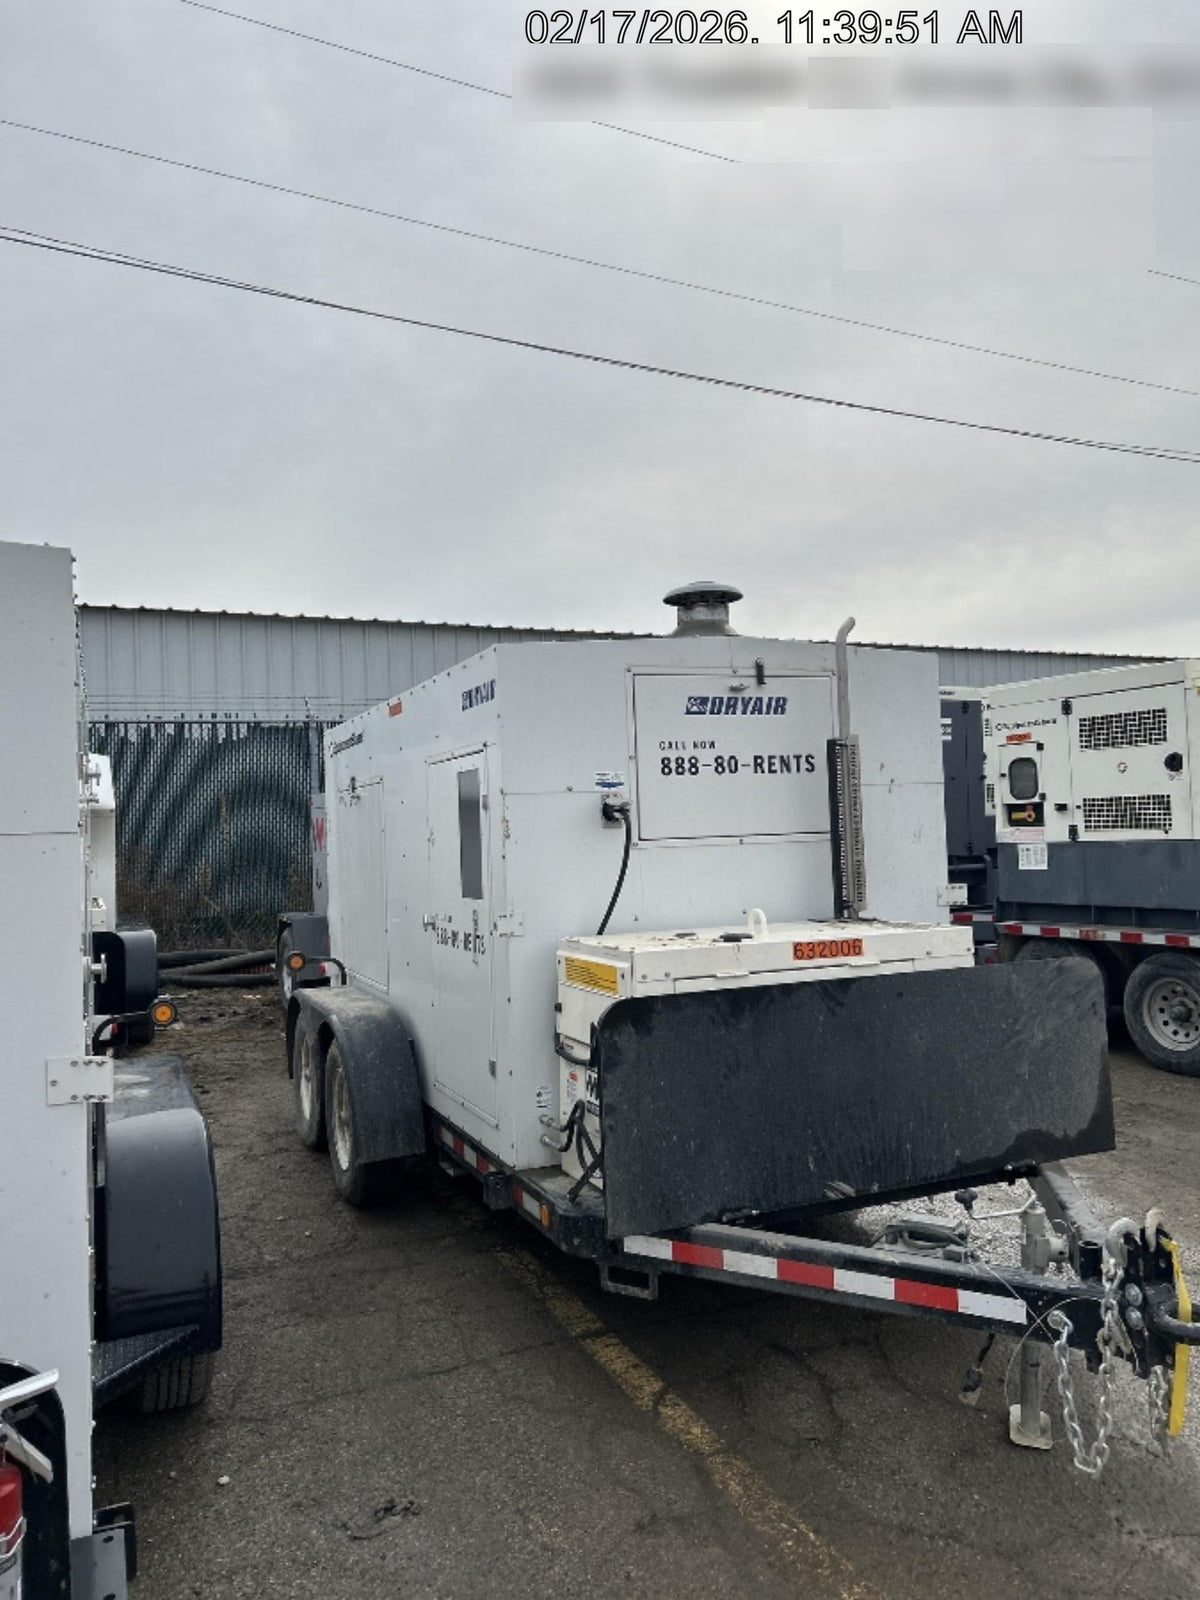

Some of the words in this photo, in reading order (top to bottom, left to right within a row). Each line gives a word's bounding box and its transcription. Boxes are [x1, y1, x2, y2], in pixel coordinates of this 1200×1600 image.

[708, 696, 788, 715] DRYAIR
[659, 741, 687, 751] CALL
[693, 740, 716, 750] NOW
[660, 754, 816, 776] 888-80-RENTS
[794, 939, 862, 960] 632006
